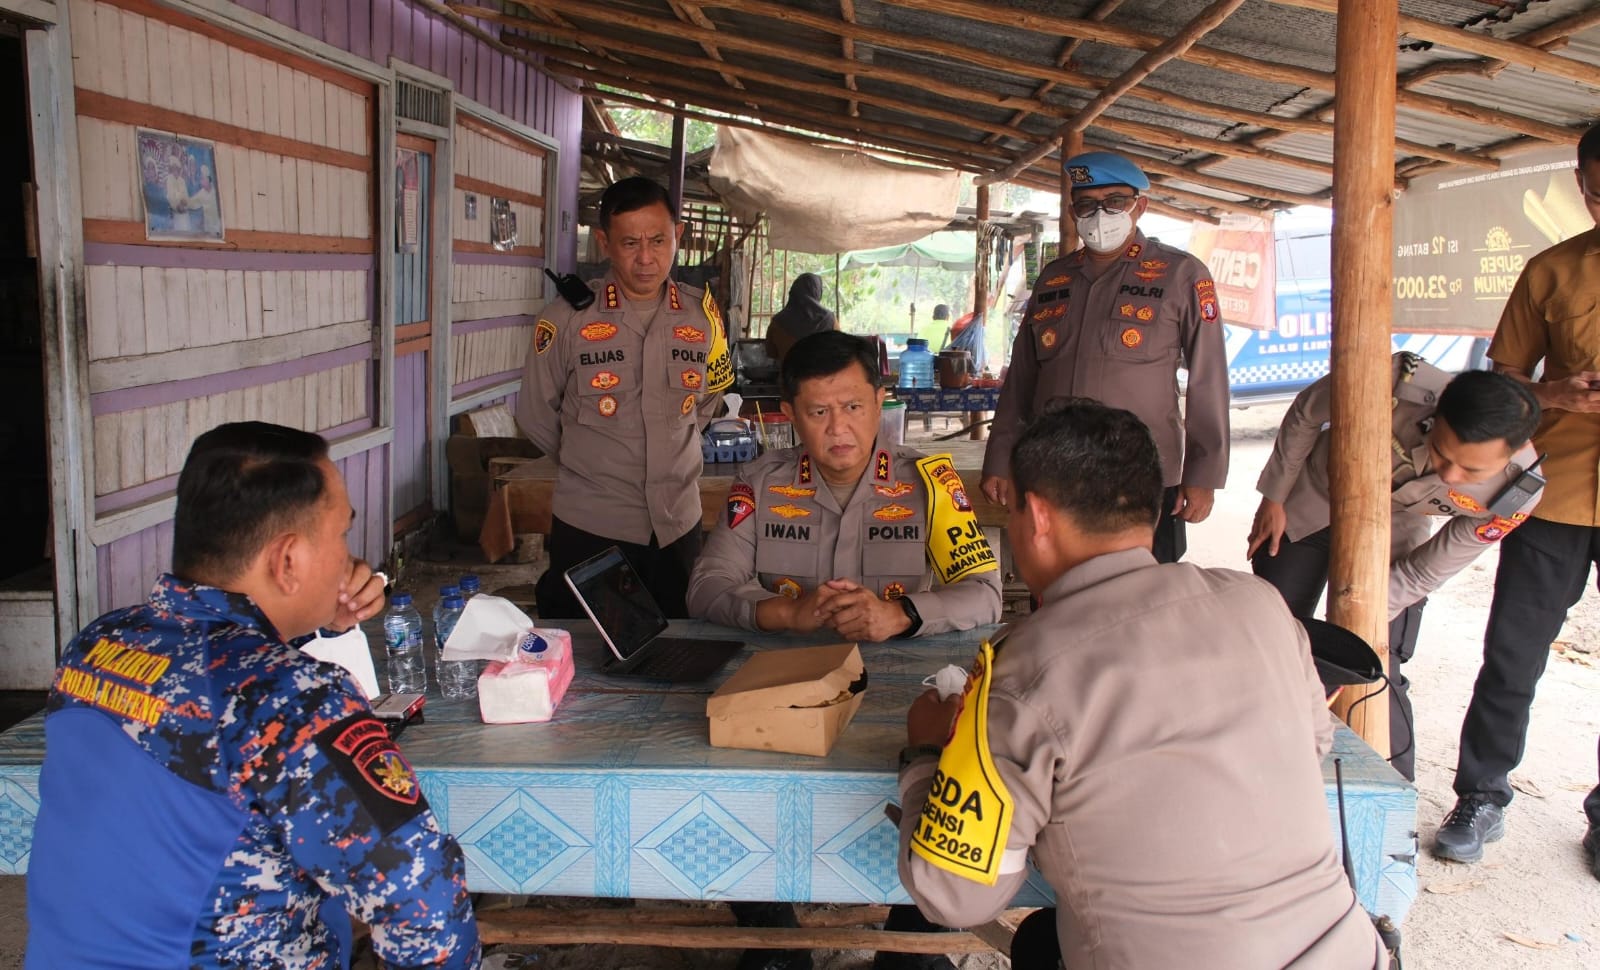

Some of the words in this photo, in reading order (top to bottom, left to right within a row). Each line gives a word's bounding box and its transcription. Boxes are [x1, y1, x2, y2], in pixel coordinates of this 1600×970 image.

[1120, 284, 1164, 299] POLRI
[1259, 312, 1331, 340] OLI
[672, 349, 707, 364] POLRI
[1259, 342, 1299, 355] LALU
[580, 350, 625, 366] ELIJAS
[708, 373, 728, 387] MAN
[765, 523, 810, 541] IWAN
[868, 525, 919, 541] POLRI
[946, 554, 977, 578] AMAN
[58, 666, 100, 703] POLDA
[97, 679, 166, 727] KALTENG
[929, 768, 984, 822] SDA
[922, 824, 984, 863] II-2026
